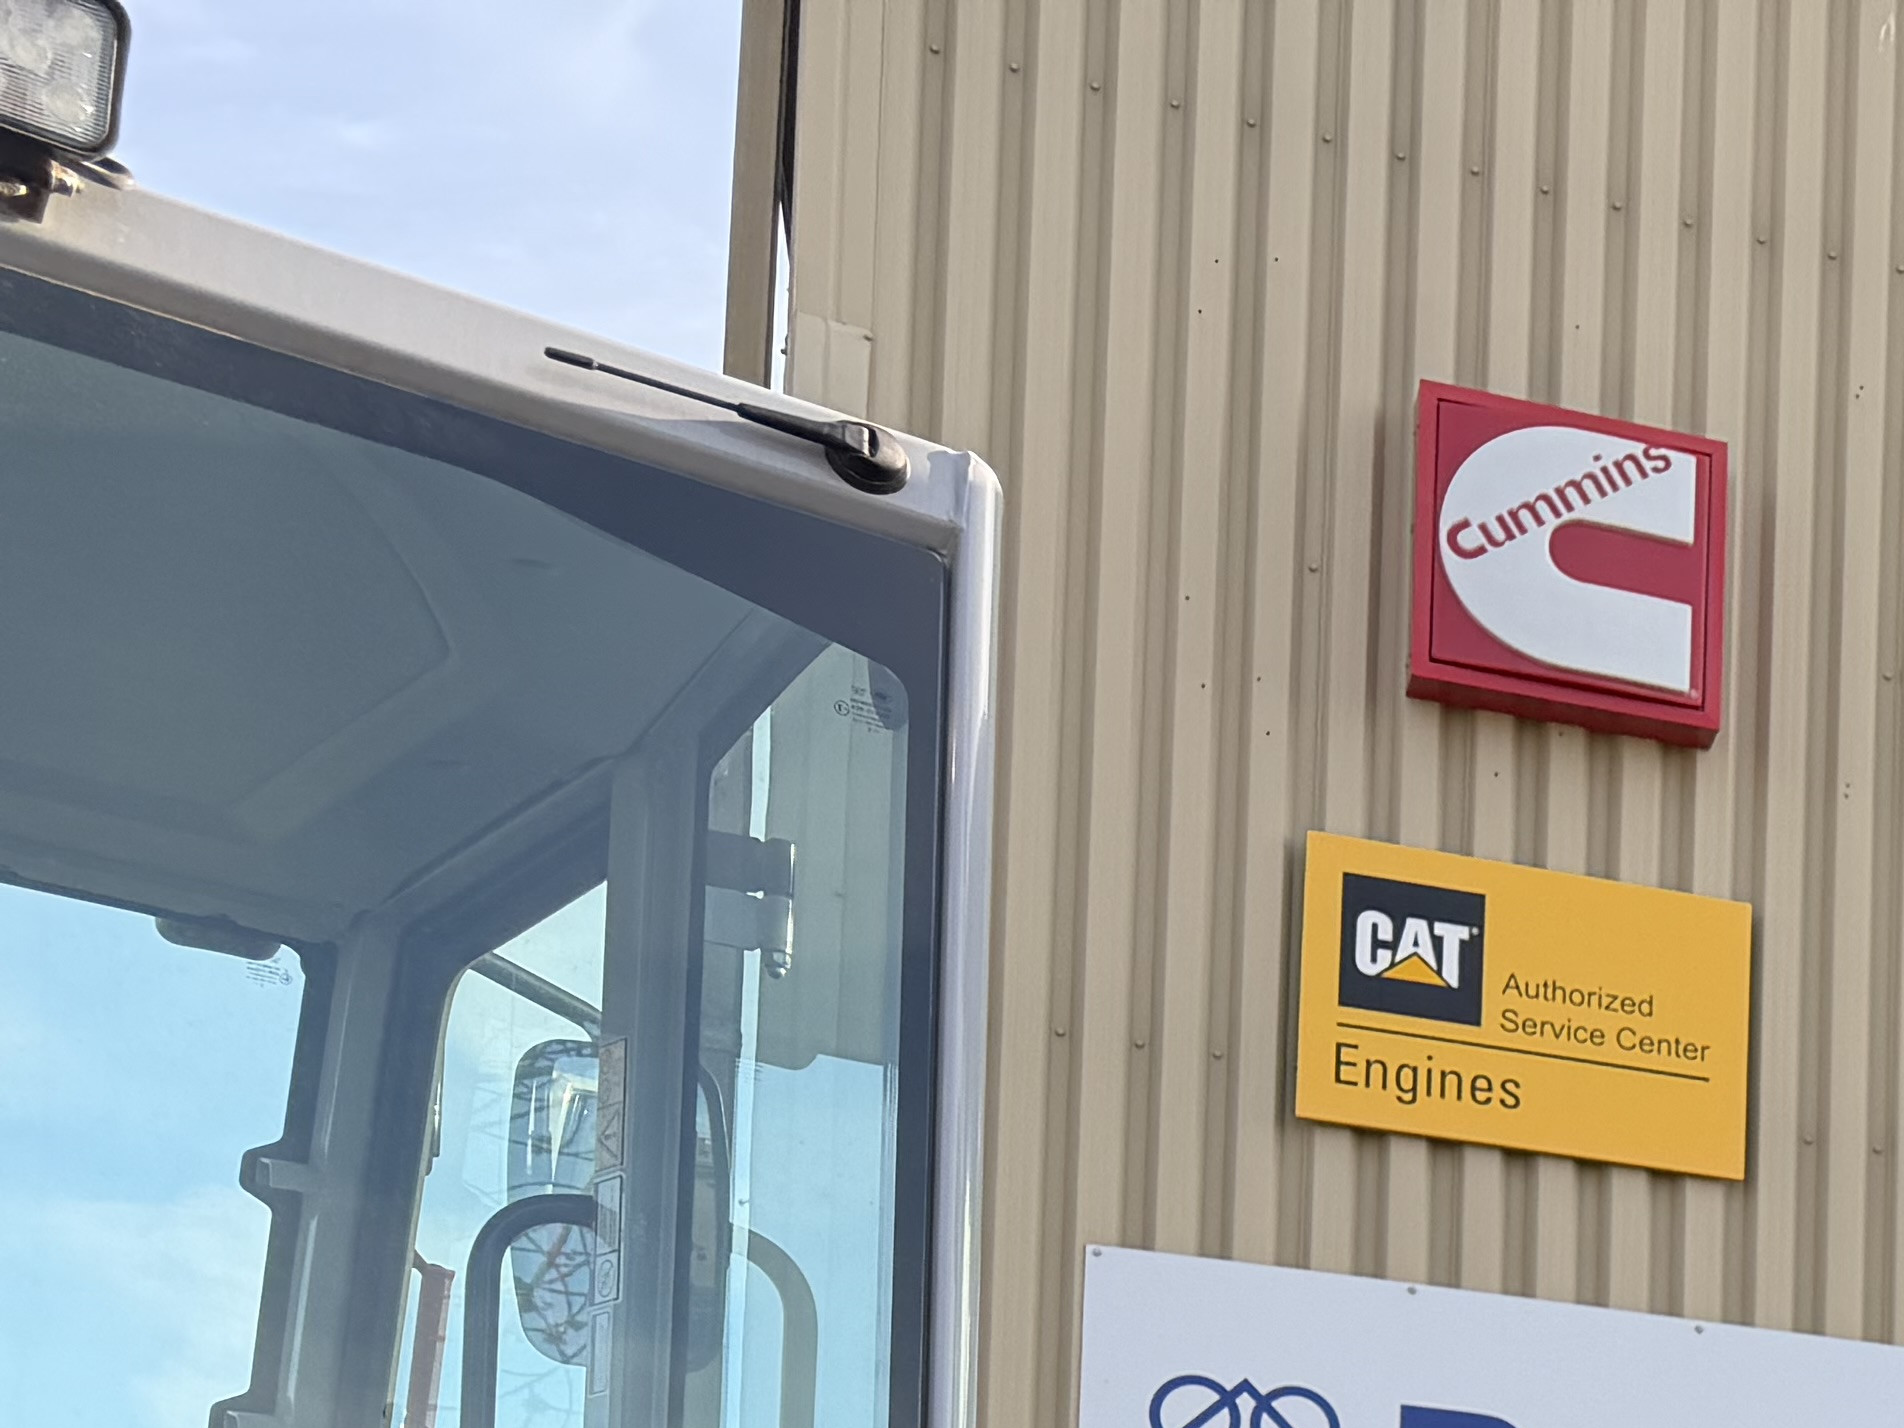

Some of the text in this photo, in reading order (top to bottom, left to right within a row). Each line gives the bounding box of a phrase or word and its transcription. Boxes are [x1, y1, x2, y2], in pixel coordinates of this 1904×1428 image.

[1446, 441, 1673, 562] Cummins
[1355, 909, 1470, 990] CAT
[1501, 973, 1655, 1019] Authorized
[1500, 1009, 1711, 1064] Service Center
[1333, 1042, 1523, 1111] Engines
